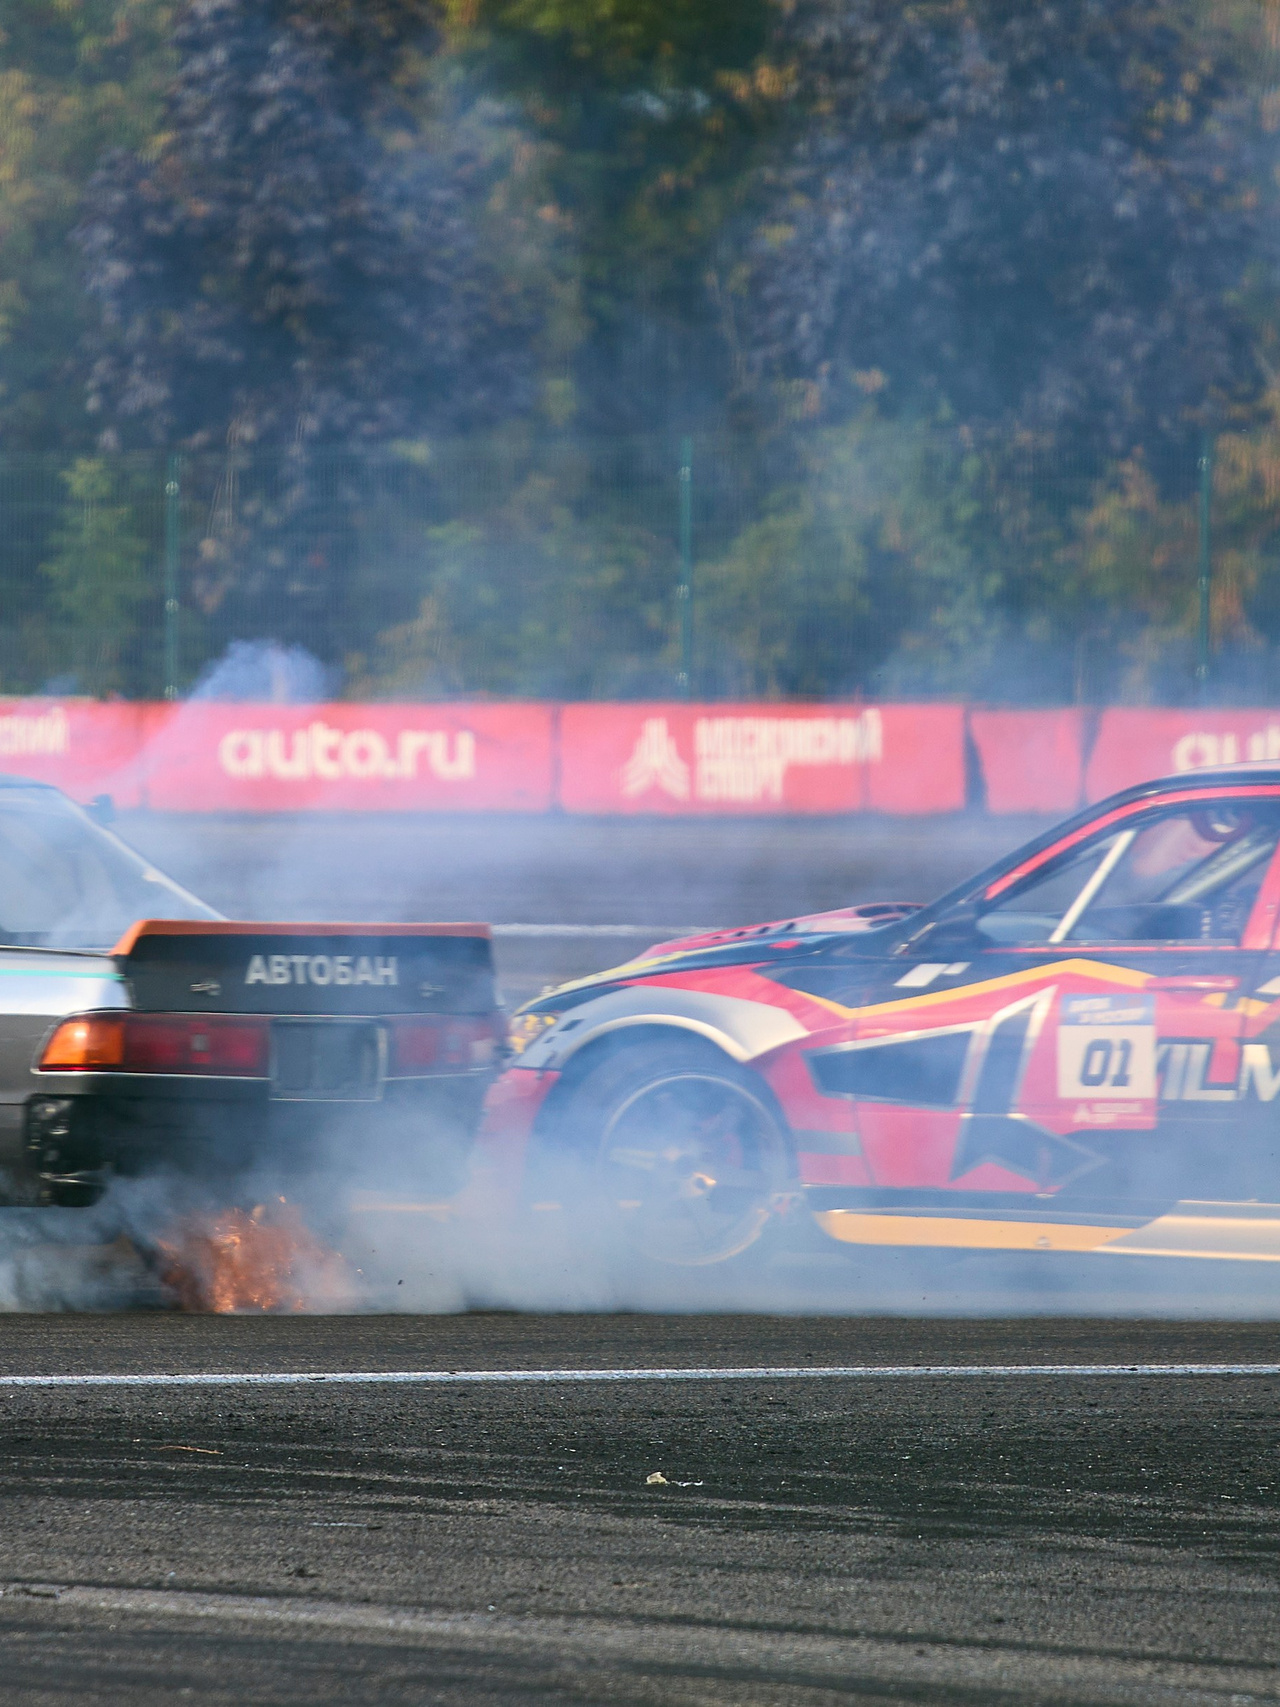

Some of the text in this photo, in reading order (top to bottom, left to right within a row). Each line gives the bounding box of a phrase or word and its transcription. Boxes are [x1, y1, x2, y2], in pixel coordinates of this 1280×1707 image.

[220, 722, 475, 780] auto.ru
[245, 954, 399, 986] АВТОБАН
[1079, 1038, 1132, 1087] 01
